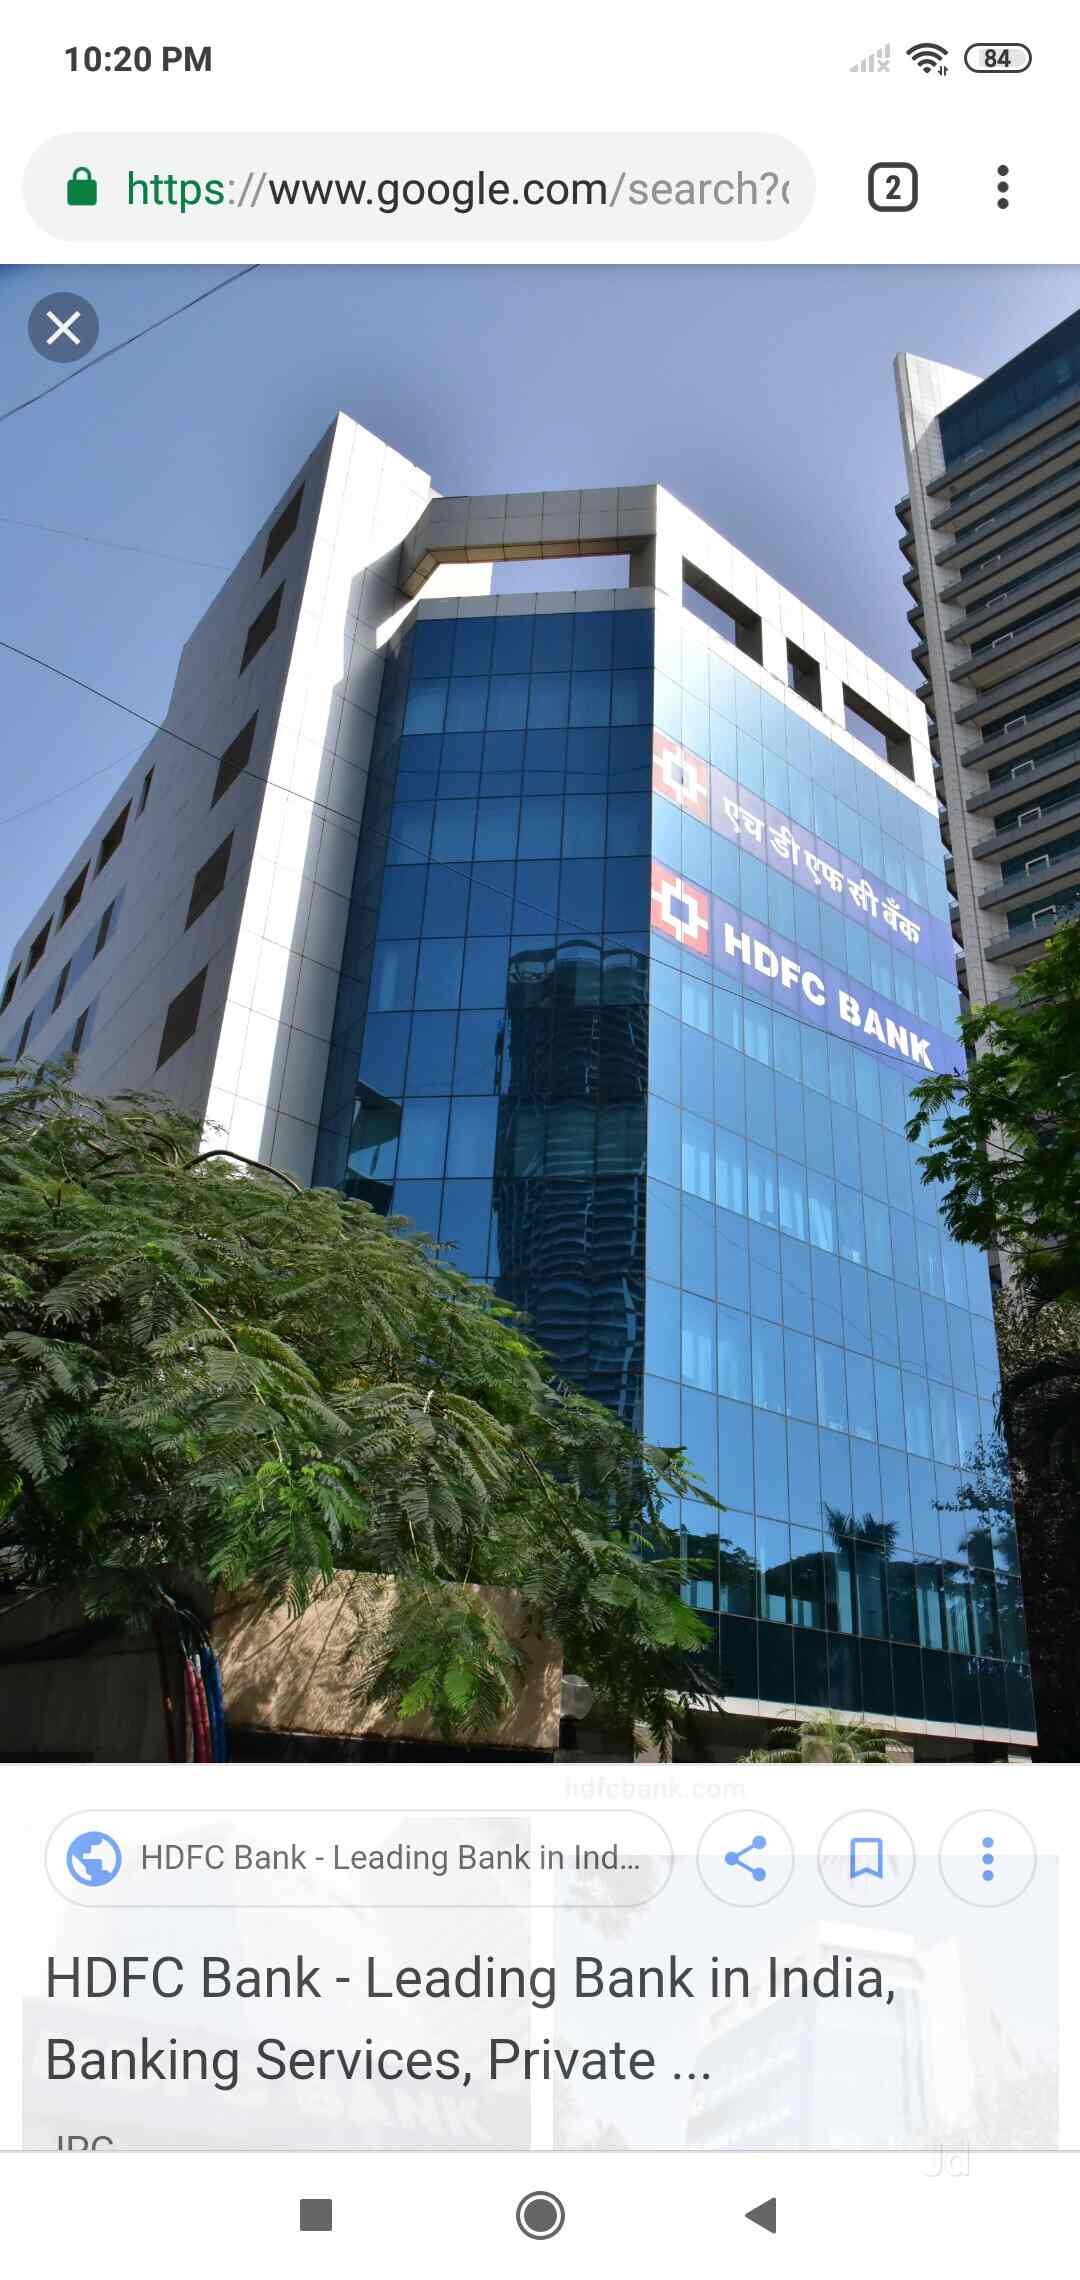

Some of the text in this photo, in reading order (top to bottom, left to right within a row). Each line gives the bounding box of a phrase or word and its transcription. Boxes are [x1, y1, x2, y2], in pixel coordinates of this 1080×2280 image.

[66, 46, 212, 72] 10:20 PM
[985, 49, 1011, 67] 84
[885, 174, 902, 200] 2
[723, 797, 764, 842] एच
[769, 825, 800, 865] डी
[804, 850, 844, 892] एफ
[848, 879, 879, 918] सी
[724, 923, 934, 1071] HDFC BANK
[142, 1845, 225, 1870] HDFC
[235, 1844, 307, 1870] Bank
[334, 1844, 448, 1877] Leading
[459, 1844, 531, 1870] Bank
[541, 1844, 564, 1870] in
[48, 1957, 184, 1998] HDFC
[203, 1955, 322, 1998] Bank
[368, 1955, 555, 2009] Leading
[575, 1955, 695, 1998] Bank
[711, 1956, 749, 1998] in
[769, 1955, 894, 2005] India,
[47, 2037, 238, 2091] Banking
[256, 2039, 471, 2088] Services,
[490, 2039, 655, 2080] Private
